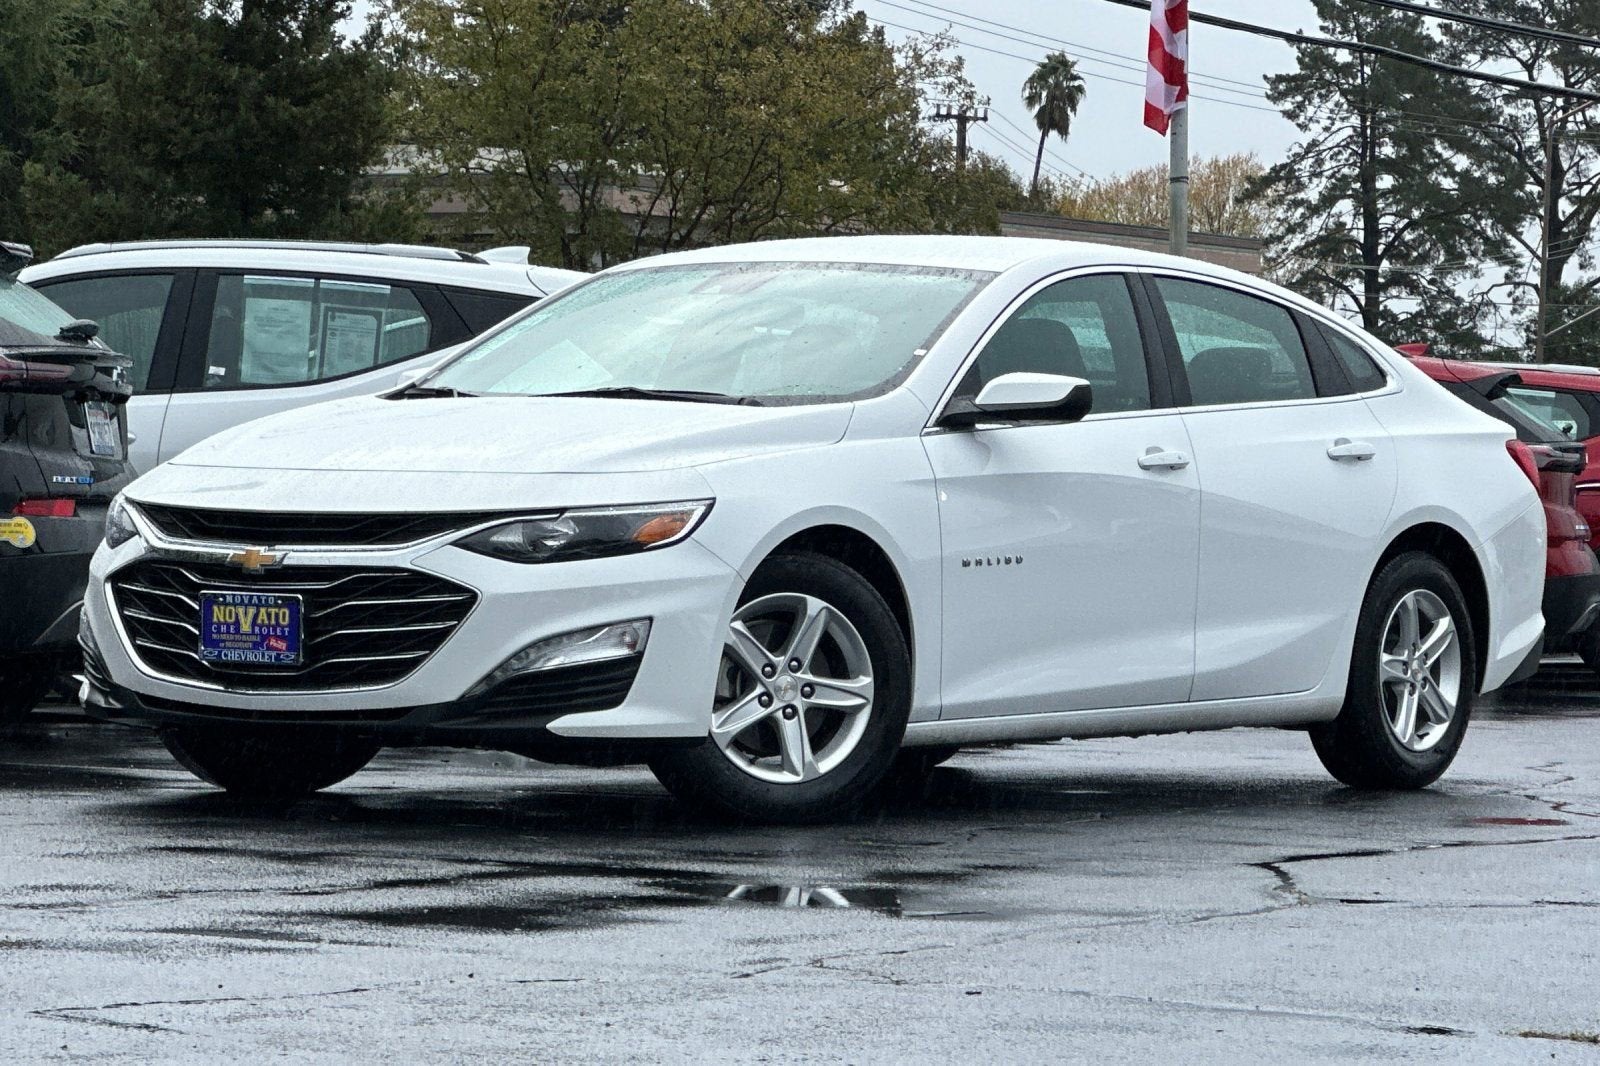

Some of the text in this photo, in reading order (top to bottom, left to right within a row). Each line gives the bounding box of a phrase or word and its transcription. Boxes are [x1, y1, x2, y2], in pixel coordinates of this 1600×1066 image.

[961, 555, 1023, 567] MALIBU
[225, 594, 275, 605] NOVATO
[212, 604, 290, 634] NOVATO
[221, 650, 277, 663] CHEVROLET
